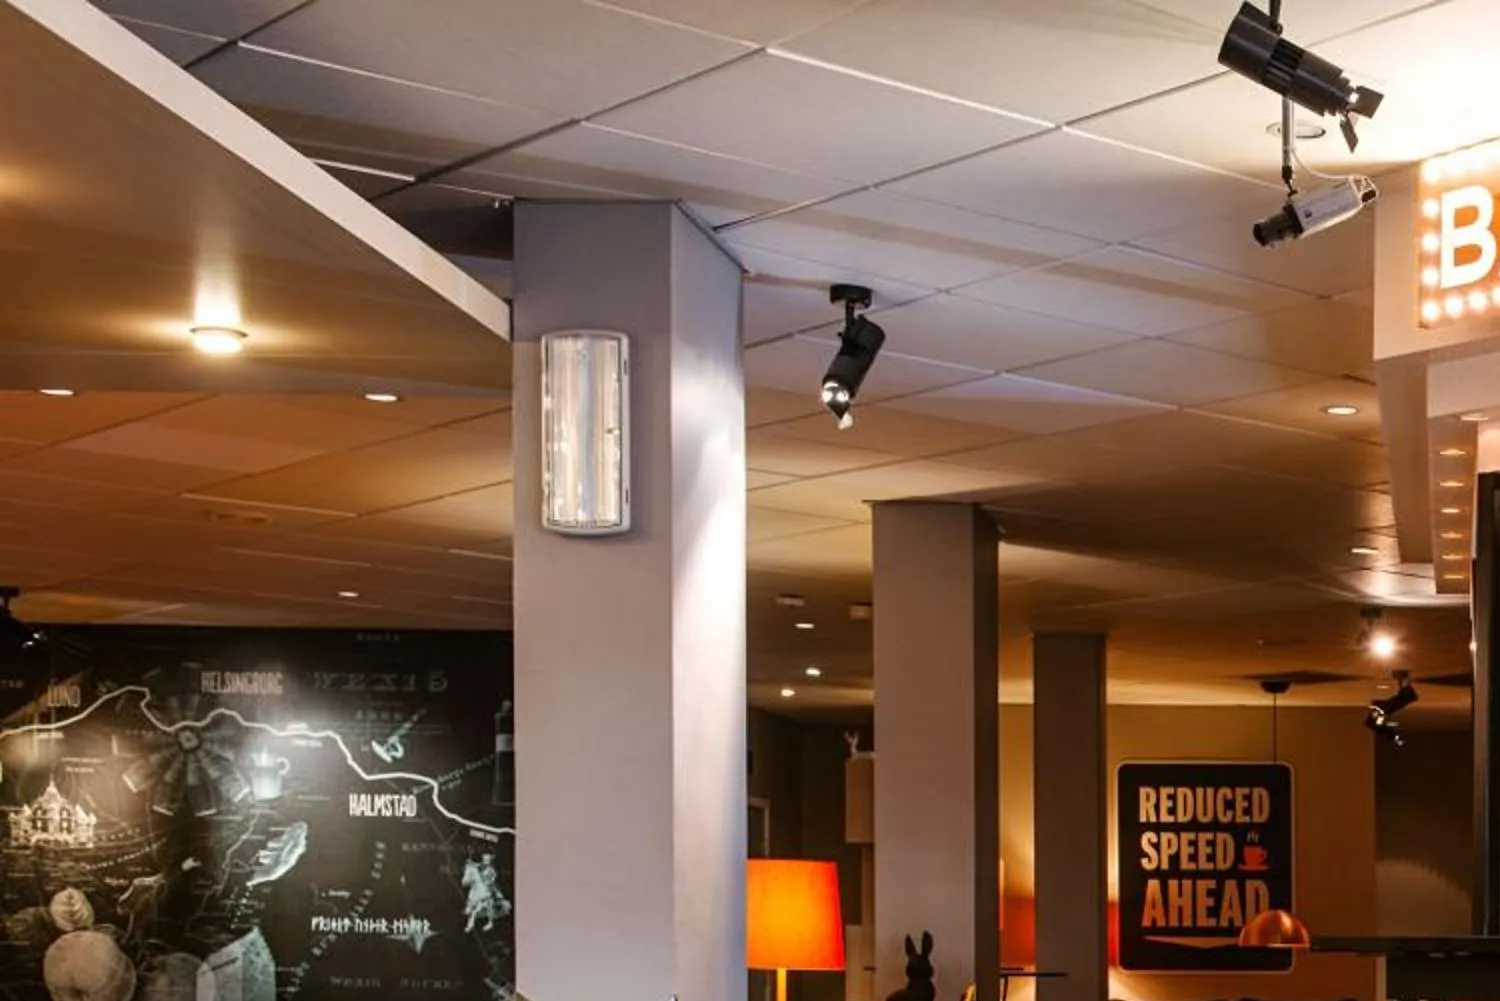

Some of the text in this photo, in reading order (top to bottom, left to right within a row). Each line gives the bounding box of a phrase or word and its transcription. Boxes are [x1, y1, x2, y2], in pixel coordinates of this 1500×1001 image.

[349, 793, 417, 817] HALMSTAD
[1139, 786, 1270, 823] REDUCED
[1140, 831, 1236, 870] SPEED
[1141, 879, 1270, 928] AHEAD
